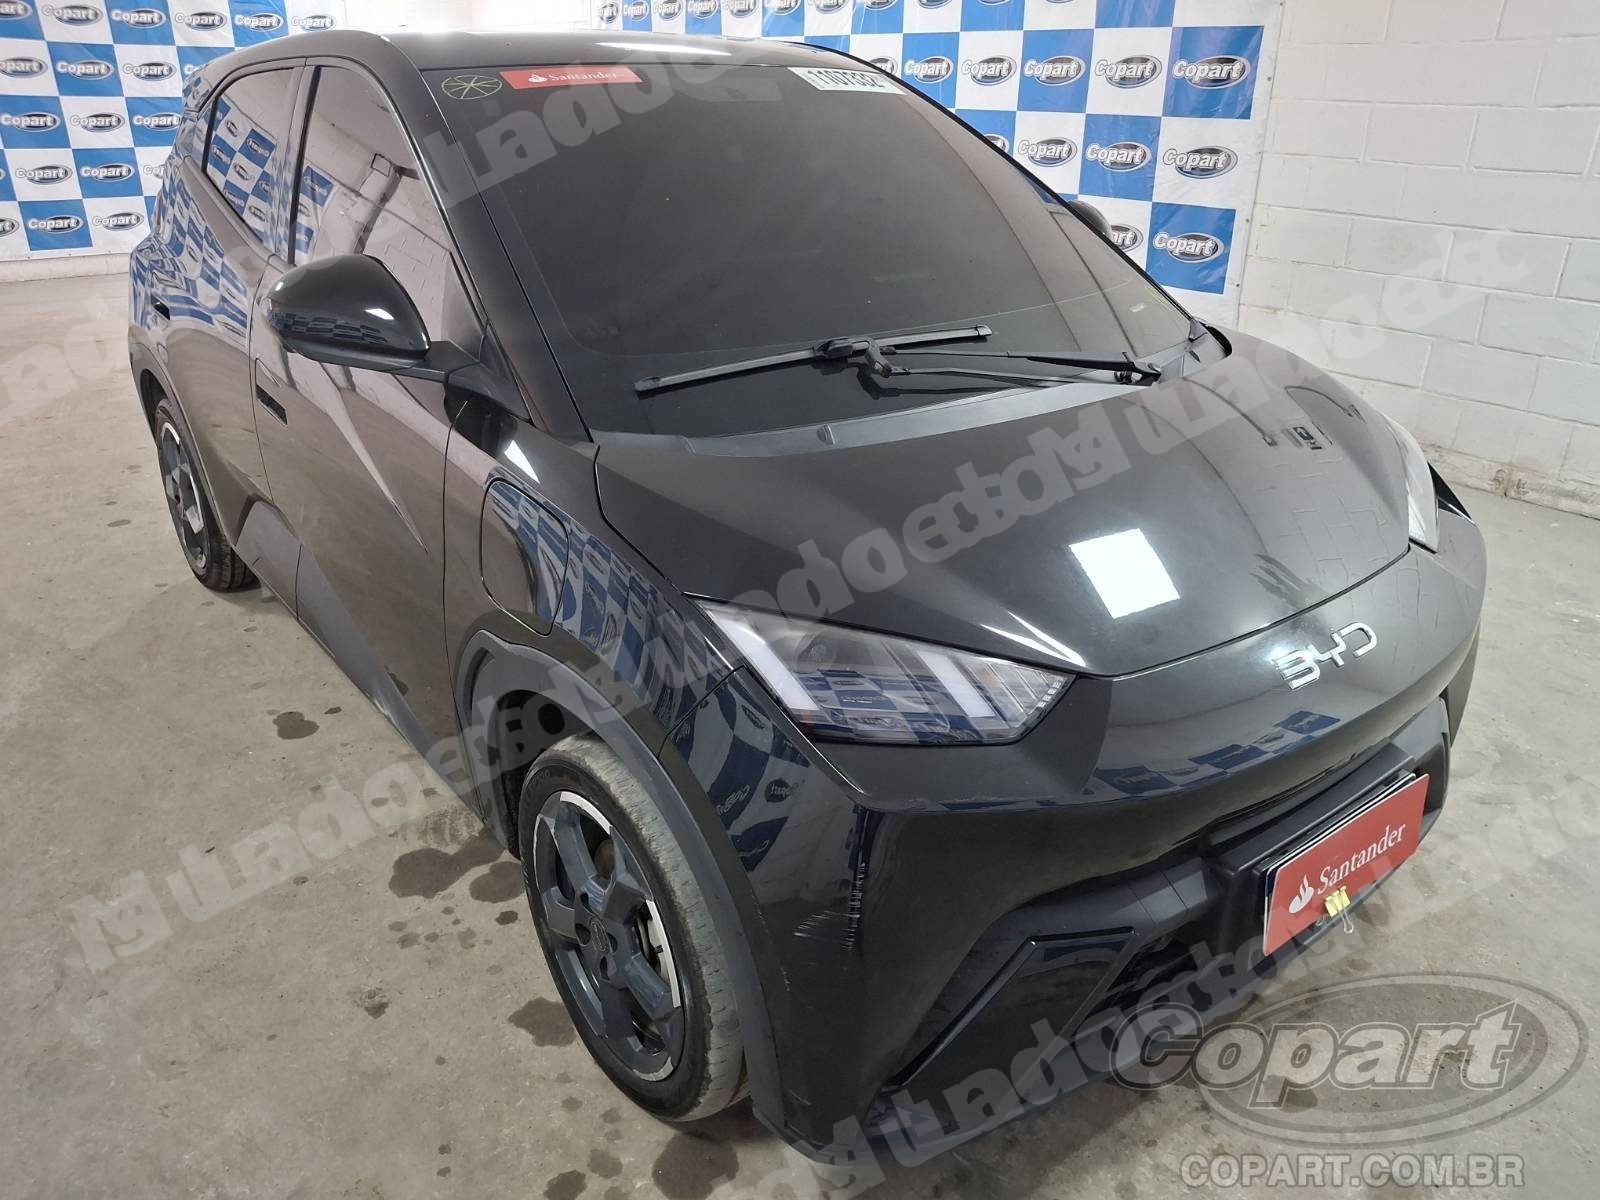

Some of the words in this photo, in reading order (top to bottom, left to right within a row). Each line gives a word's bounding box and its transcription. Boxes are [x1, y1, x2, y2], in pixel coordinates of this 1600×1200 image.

[43, 5, 98, 20] Copart
[111, 10, 161, 24] Copart
[175, 13, 221, 27] Copart
[235, 14, 279, 28] Copart
[291, 16, 332, 29] Copart
[0, 61, 42, 77] opart
[57, 62, 108, 77] Copart
[123, 64, 172, 79] Copart
[548, 70, 618, 82] Santander
[905, 59, 948, 78] Copart
[962, 59, 1010, 79] Copart
[1024, 59, 1079, 80] Copart
[1095, 59, 1154, 81] Copart
[1172, 59, 1243, 83] Copart
[1, 114, 54, 128] Copart
[70, 114, 120, 128] Copart
[133, 114, 180, 128] Copart
[1018, 140, 1071, 160] Copart
[1086, 143, 1146, 164] Copart
[1163, 148, 1228, 171] Copart
[15, 168, 65, 181] Copart
[80, 166, 129, 179] Copart
[27, 218, 77, 232] Copart
[92, 214, 138, 228] Copart
[1111, 230, 1135, 245] art
[1153, 232, 1215, 255] Copart
[1271, 621, 1377, 690] BYD
[1317, 823, 1407, 896] Santander
